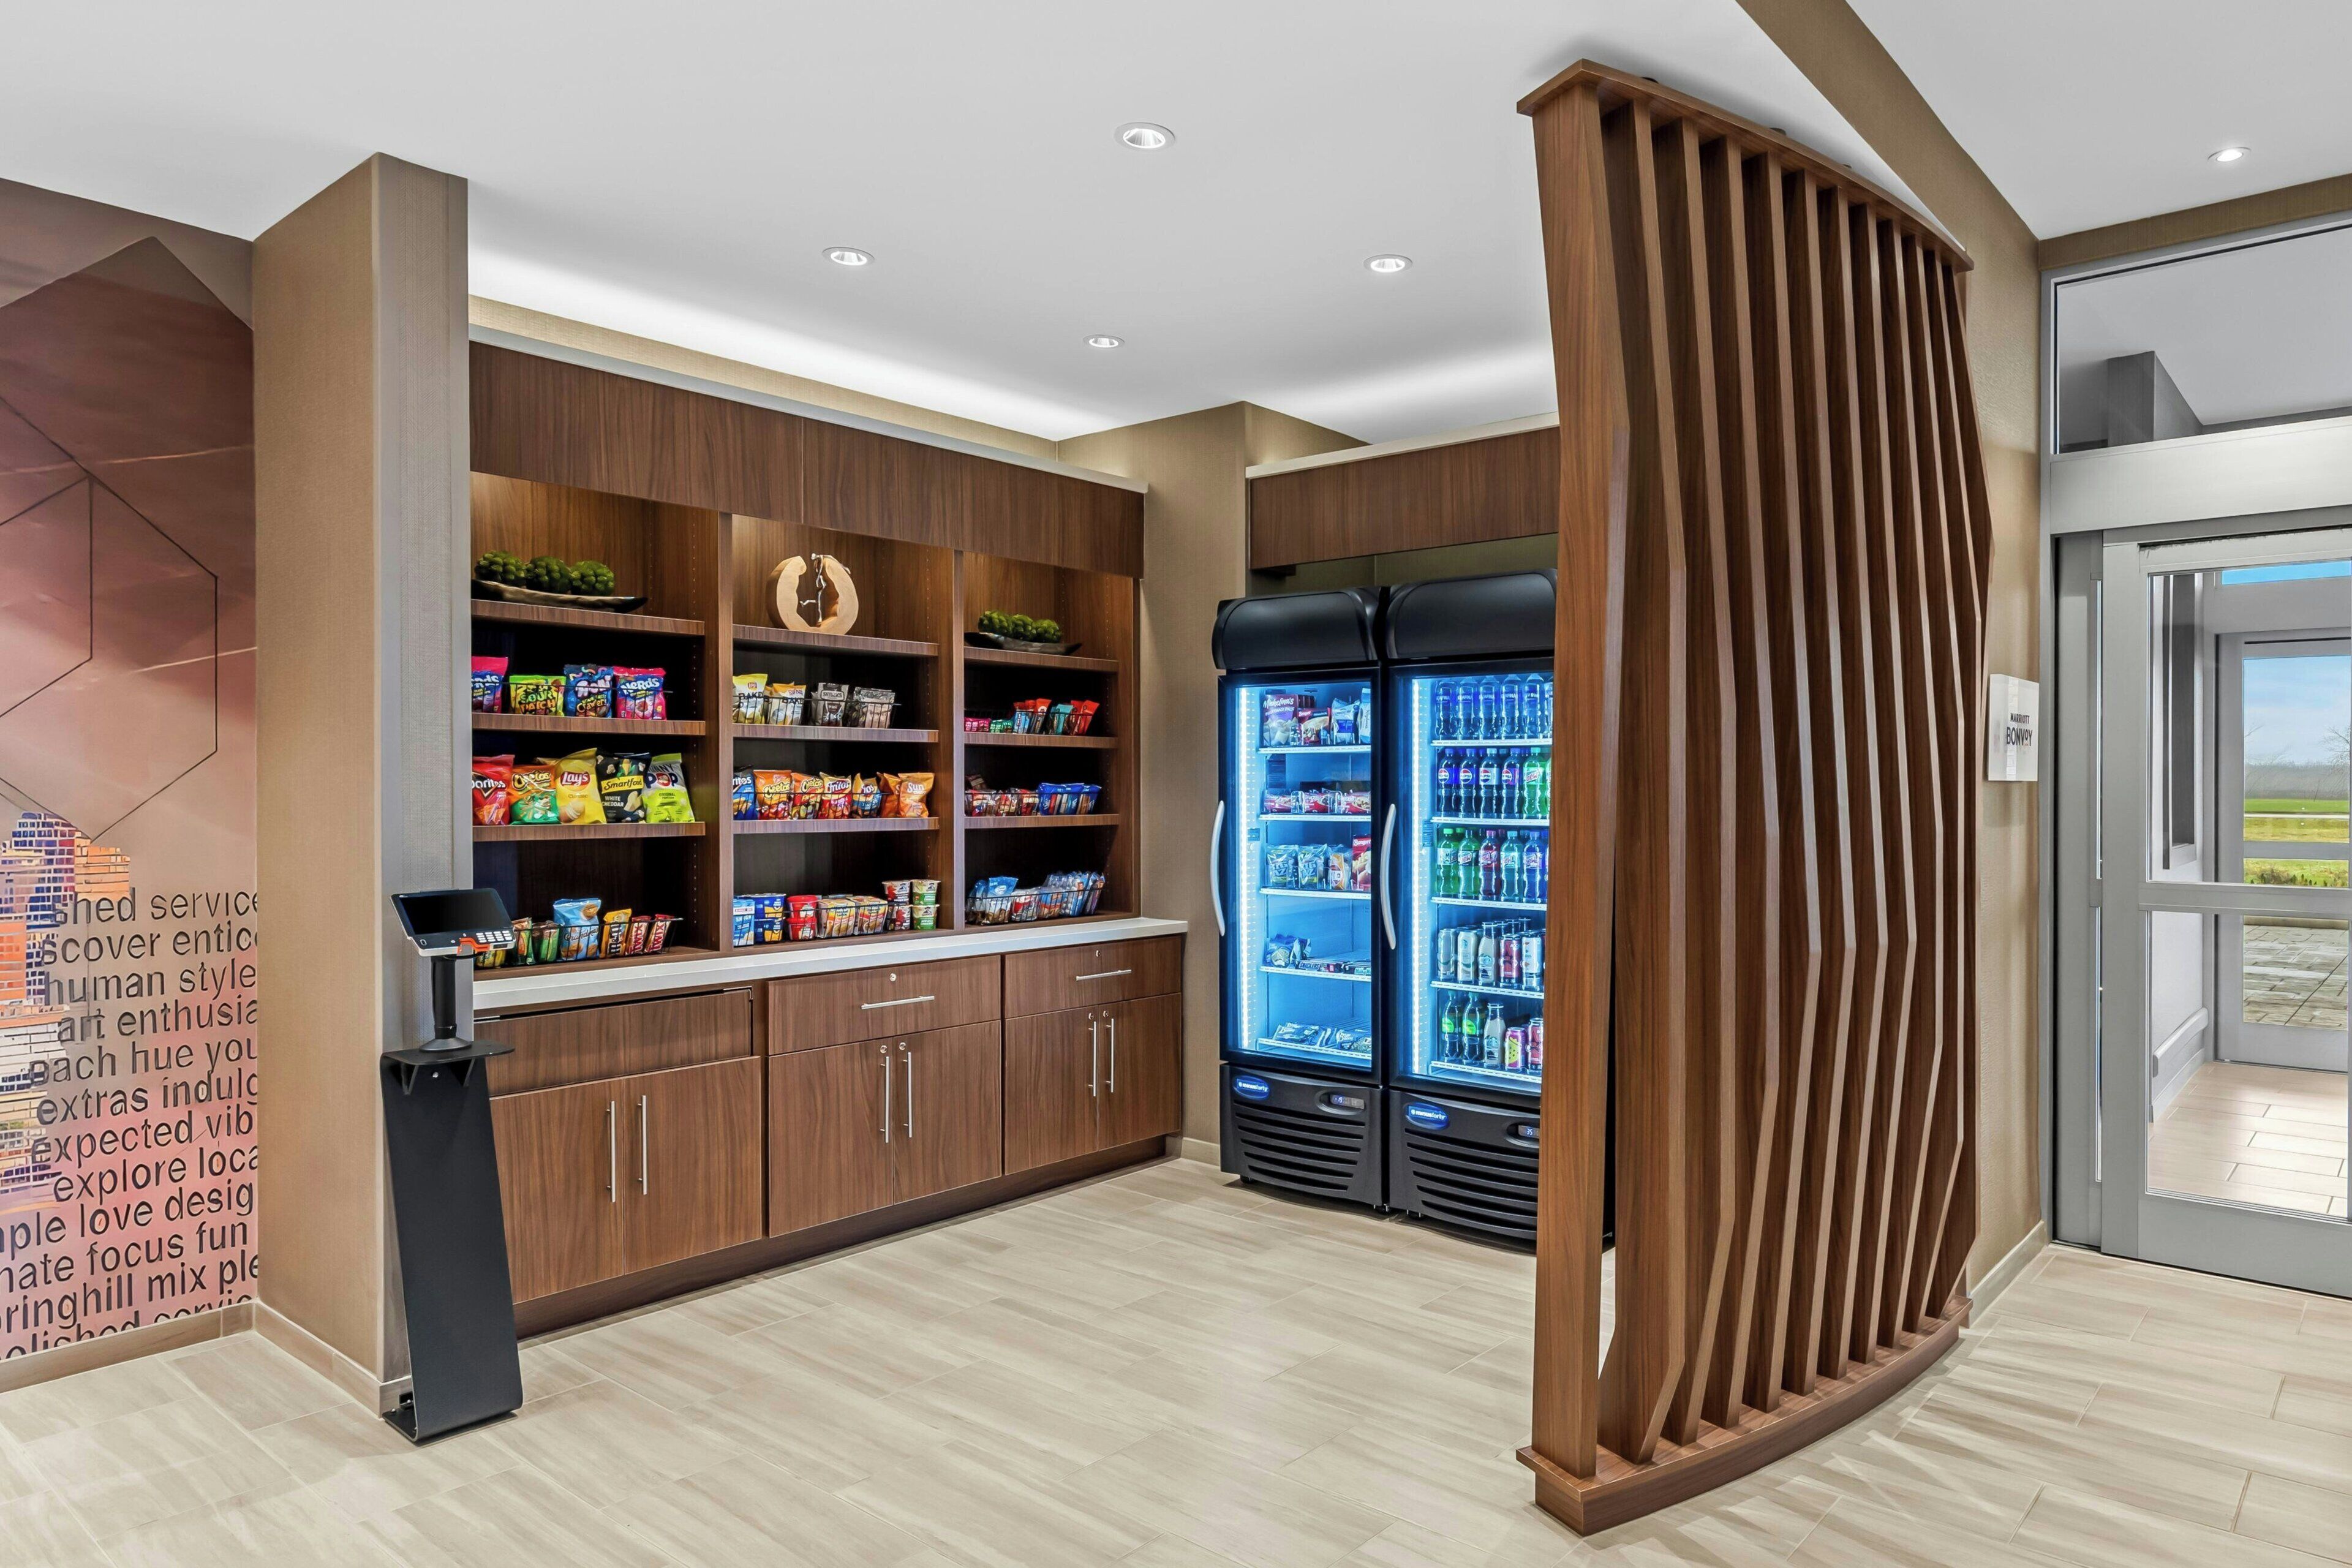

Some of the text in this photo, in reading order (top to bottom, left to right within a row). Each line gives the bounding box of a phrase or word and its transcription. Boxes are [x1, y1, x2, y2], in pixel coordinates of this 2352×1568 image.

[2010, 712, 2030, 725] MARRIOTT
[562, 772, 588, 786] Lay's
[907, 782, 924, 794] Sun
[173, 920, 257, 956] entic
[45, 958, 256, 1006] human style
[132, 1041, 194, 1074] hue
[37, 1087, 148, 1125] extras
[1415, 1110, 1446, 1120] minusforty
[31, 1104, 254, 1169] expected vib
[54, 1158, 187, 1206] explore
[0, 1178, 253, 1261] ple love desig
[86, 1233, 184, 1276] focus
[196, 1221, 247, 1254] fun
[148, 1262, 207, 1302] mix
